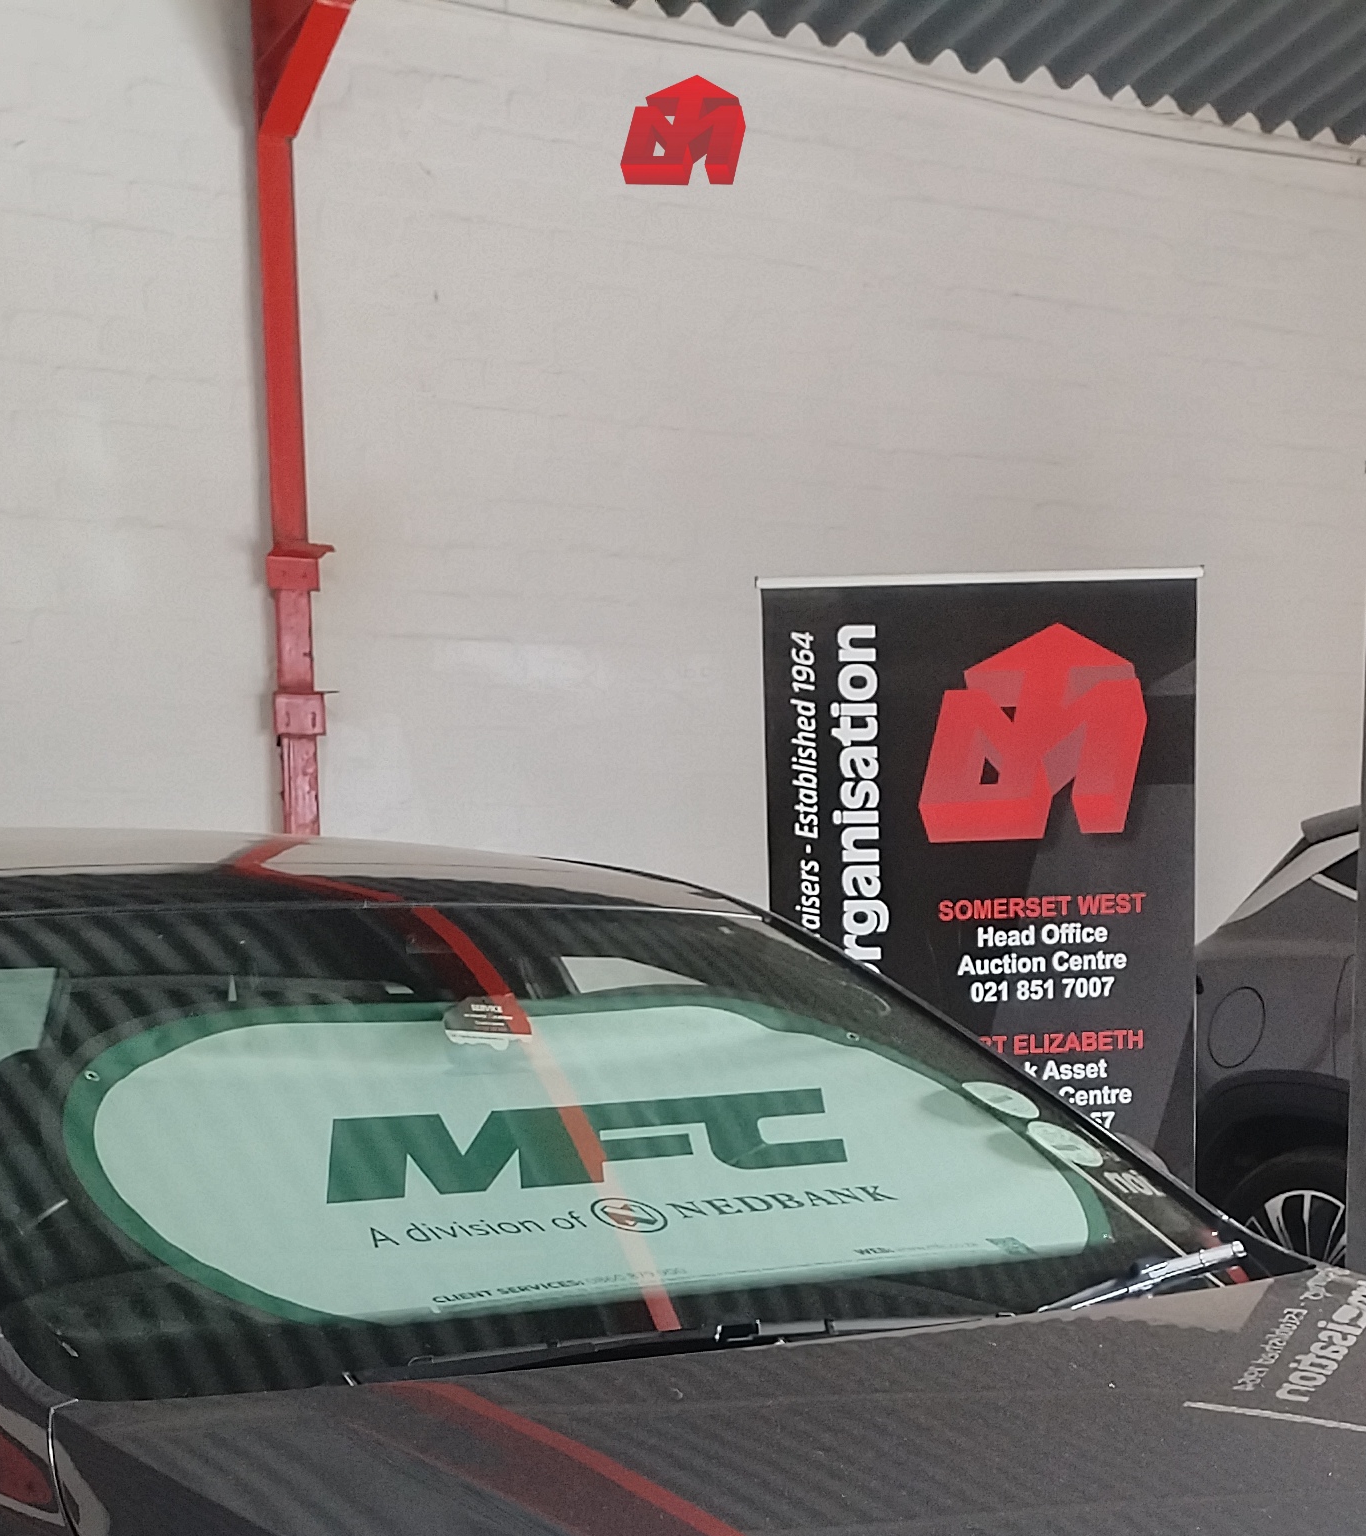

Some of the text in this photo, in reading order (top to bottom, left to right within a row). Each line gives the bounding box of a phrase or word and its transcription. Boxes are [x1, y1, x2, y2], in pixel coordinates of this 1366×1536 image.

[790, 630, 816, 693] 1964
[790, 699, 819, 839] Established
[830, 624, 889, 973] rganisation
[795, 859, 821, 937] aisers
[938, 892, 1146, 921] SOMERSET WEST
[977, 923, 1108, 948] Head Office
[957, 950, 1127, 976] Auction Centre
[970, 977, 1115, 1002] 021 851 7007
[1014, 1029, 1144, 1055] ELIZABETH
[1043, 1058, 1108, 1080] Asset
[370, 1185, 898, 1249] A division of NEDBANK
[432, 1289, 492, 1304] CLIENT
